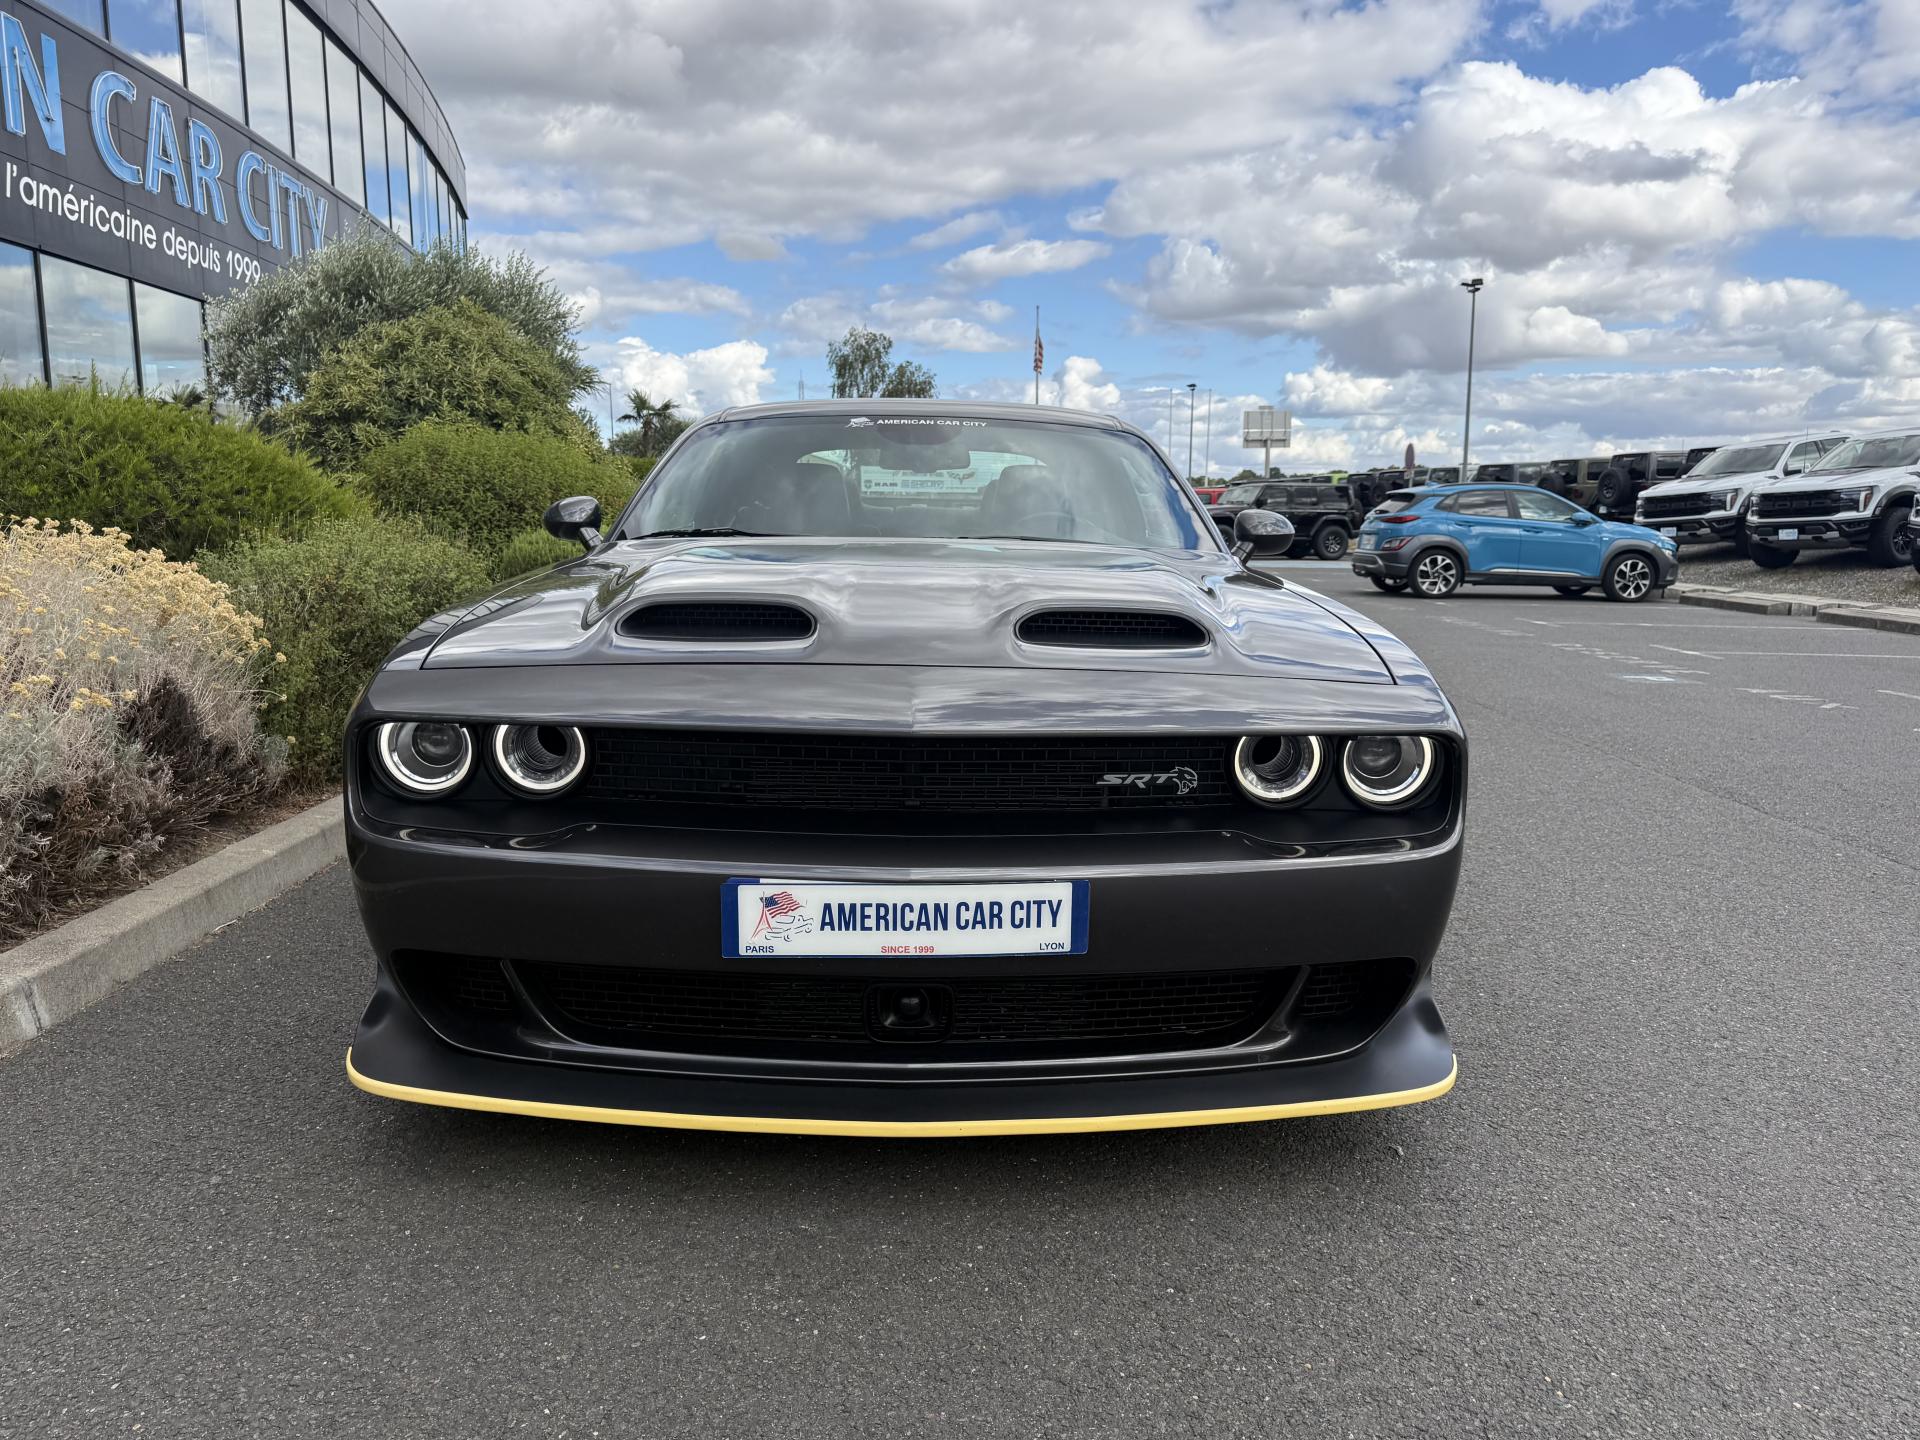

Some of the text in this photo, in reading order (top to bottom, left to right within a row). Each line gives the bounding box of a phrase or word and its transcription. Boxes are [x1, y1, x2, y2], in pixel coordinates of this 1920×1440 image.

[90, 71, 228, 225] CAR
[237, 150, 328, 258] CITY
[163, 227, 221, 273] depuis
[226, 250, 261, 285] 1999
[1096, 773, 1178, 788] SRT
[819, 899, 1063, 932] AMERICAN CAR CITY
[745, 944, 775, 954] PARIS
[880, 945, 935, 954] SINCE 1999
[1039, 942, 1065, 951] LYON
